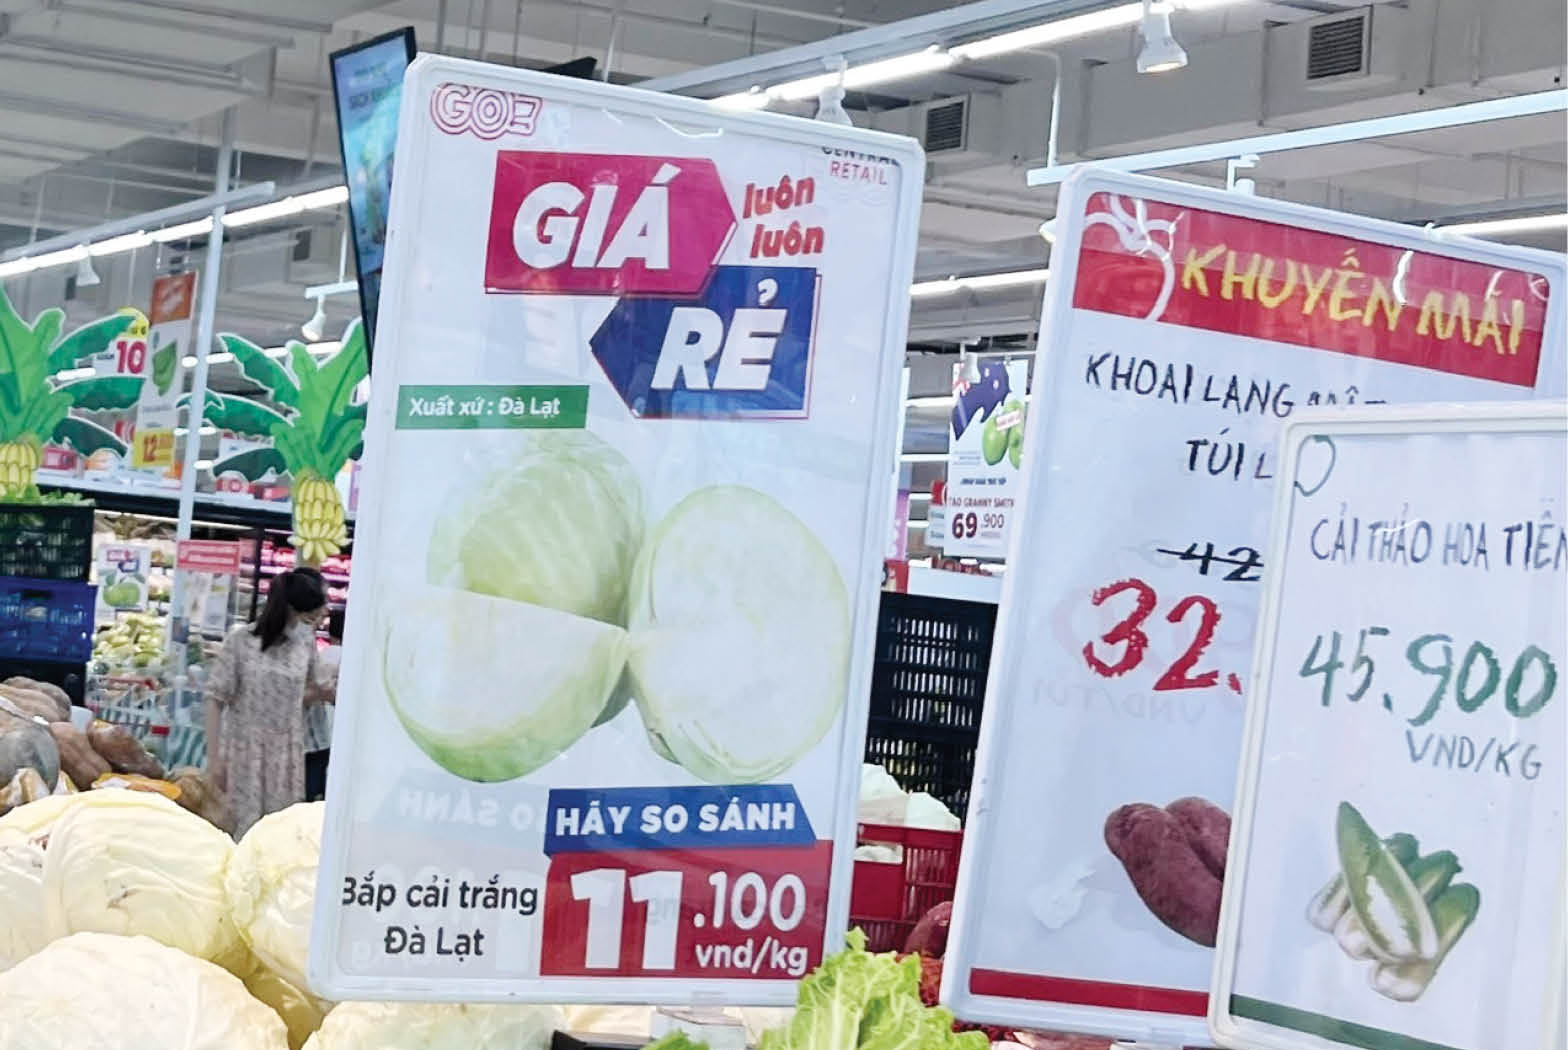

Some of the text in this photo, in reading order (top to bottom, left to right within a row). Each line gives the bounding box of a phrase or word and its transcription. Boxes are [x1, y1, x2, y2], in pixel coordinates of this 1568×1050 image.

[830, 160, 888, 186] RETAIL
[512, 162, 682, 270] GIÁ
[742, 174, 816, 220] luôn
[749, 220, 825, 259] luôn
[650, 278, 789, 391] RẺ
[409, 395, 454, 417] Xuất
[498, 396, 525, 416] Đà
[530, 396, 561, 419] Lạt
[1086, 352, 1193, 405] KHOAI
[1203, 374, 1294, 419] LANG
[1186, 427, 1245, 481] TÚI
[1442, 521, 1489, 571] HOA
[1298, 626, 1558, 728] 45.900
[1405, 729, 1543, 781] VND/KG
[555, 797, 796, 837] HÃY SO SÁNH
[406, 874, 450, 909] cải
[458, 873, 539, 916] trắng
[383, 924, 485, 963] Đà Lạt
[695, 936, 809, 976] vnd/kg
